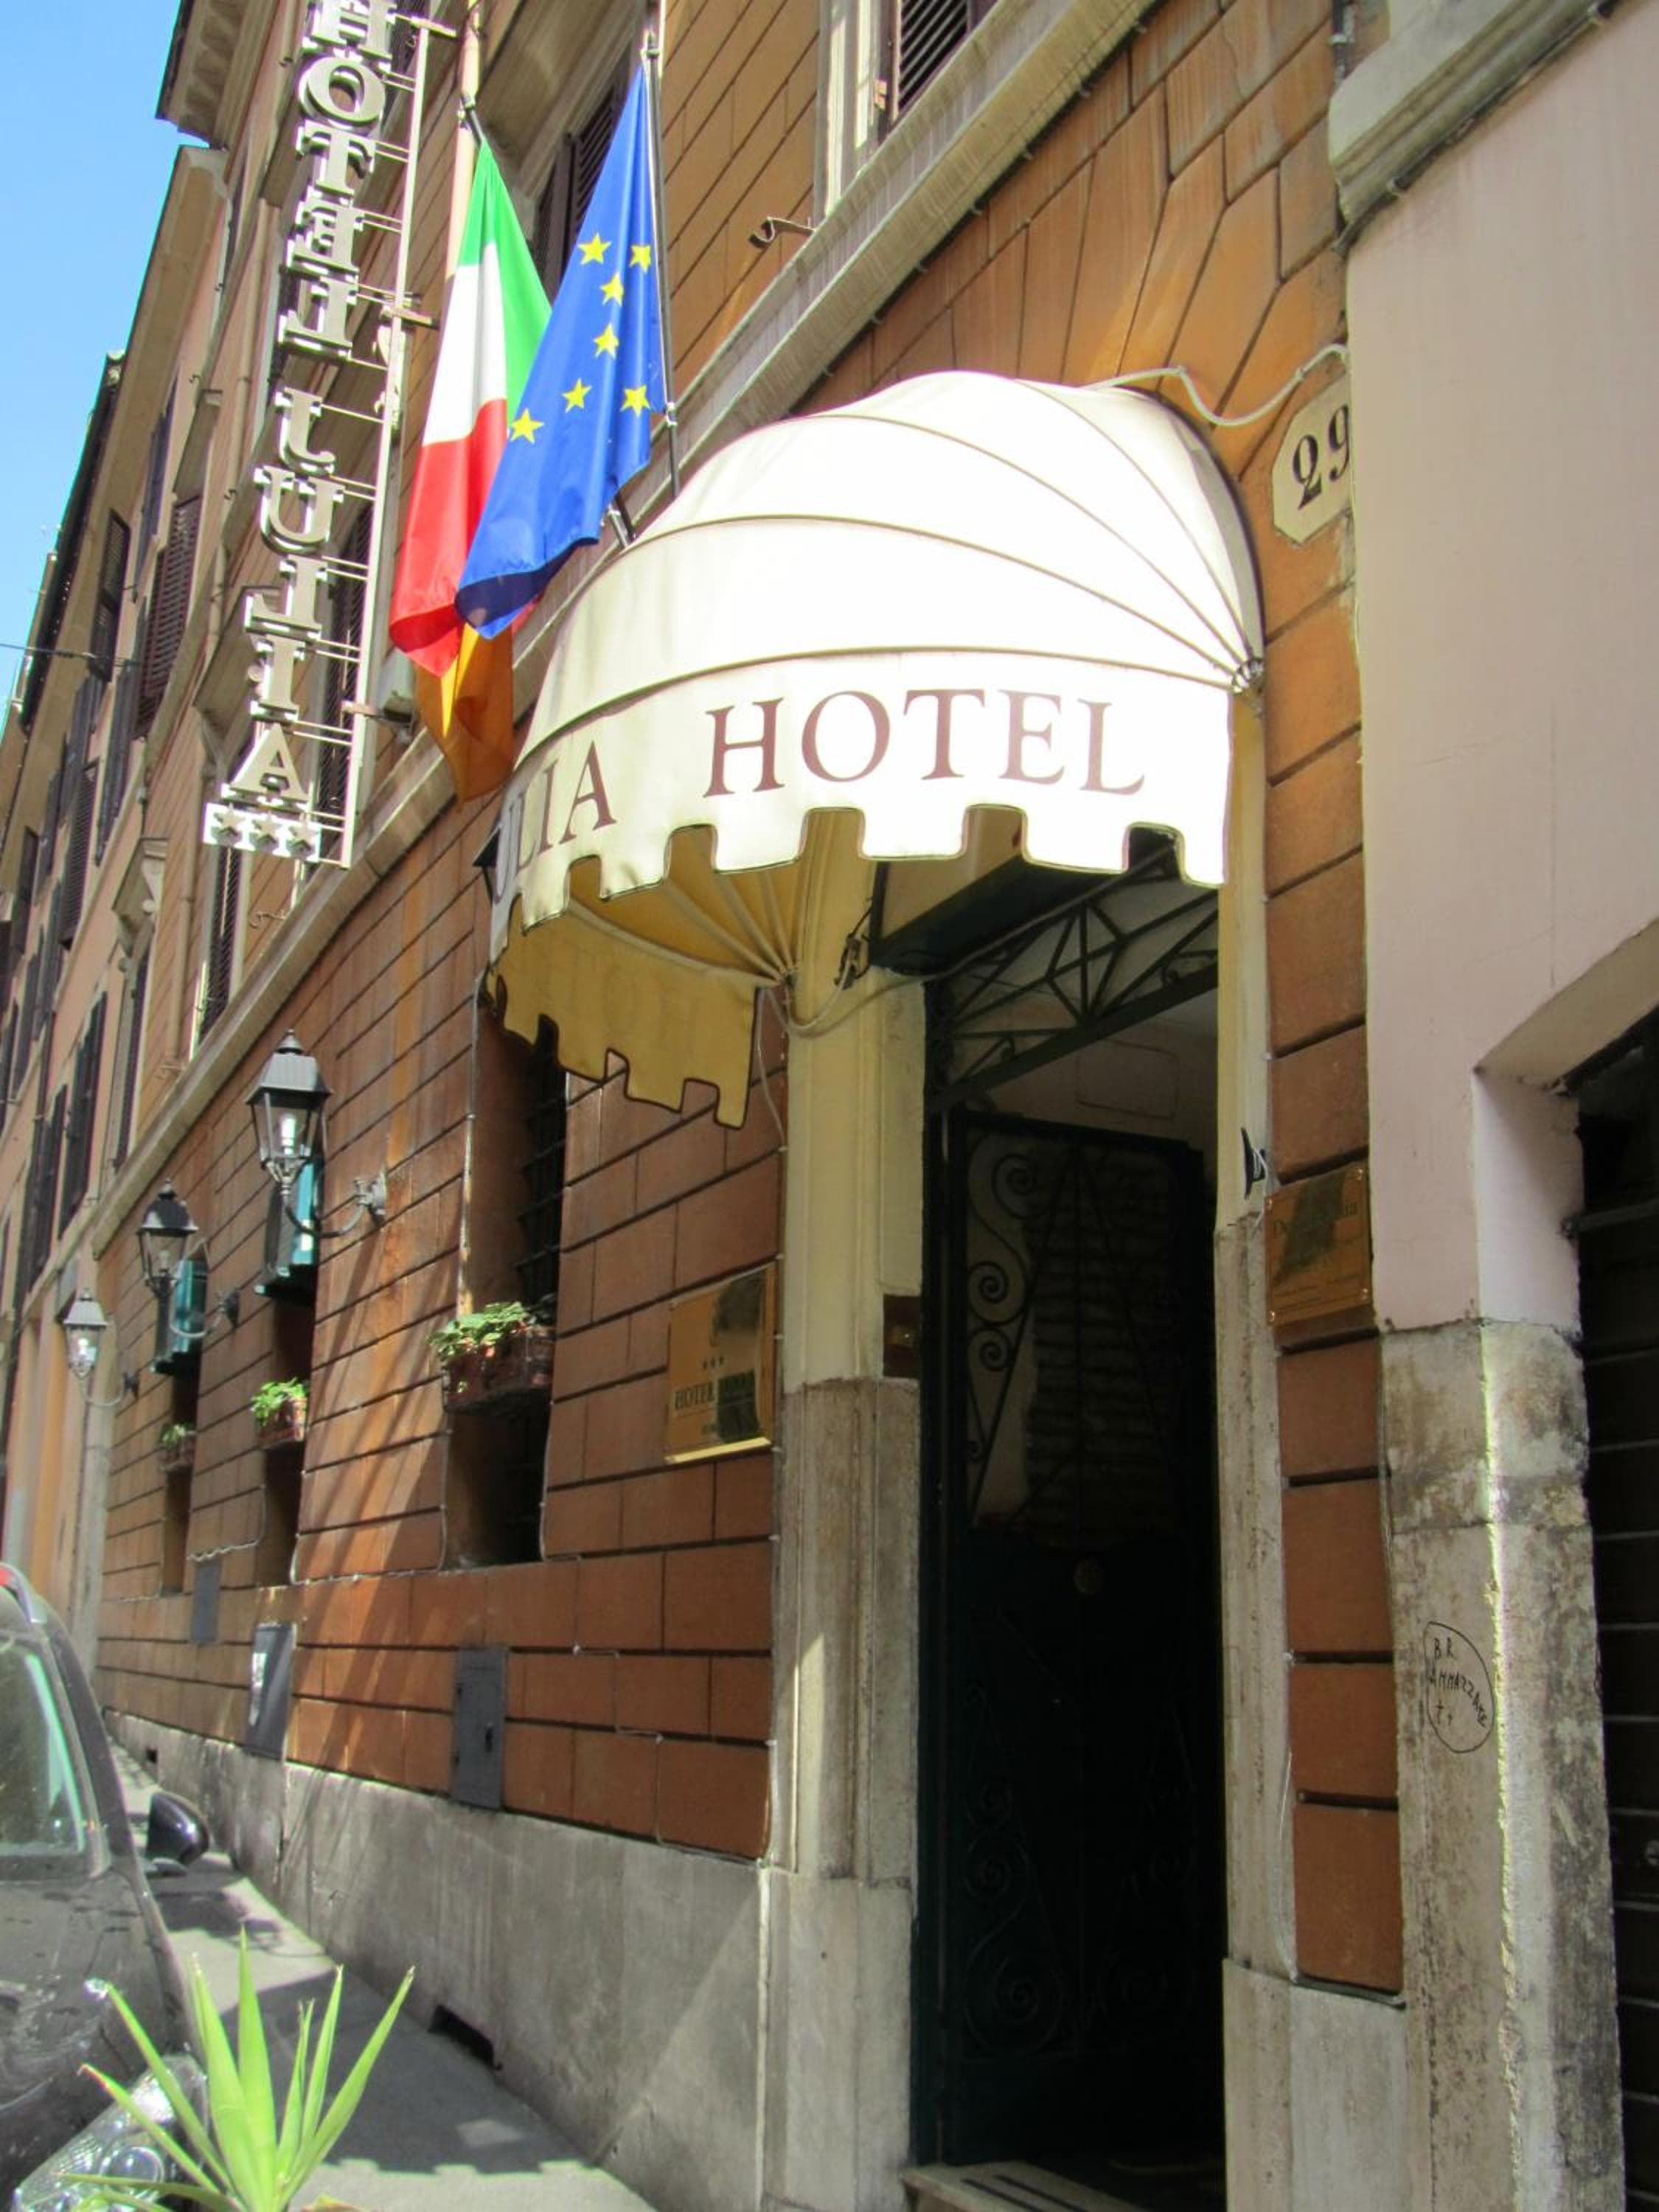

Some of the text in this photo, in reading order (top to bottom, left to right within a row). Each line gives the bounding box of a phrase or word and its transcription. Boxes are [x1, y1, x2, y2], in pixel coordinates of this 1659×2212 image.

[1293, 404, 1350, 511] 29
[703, 688, 1147, 799] HOTEL
[675, 1381, 715, 1411] HOTEL
